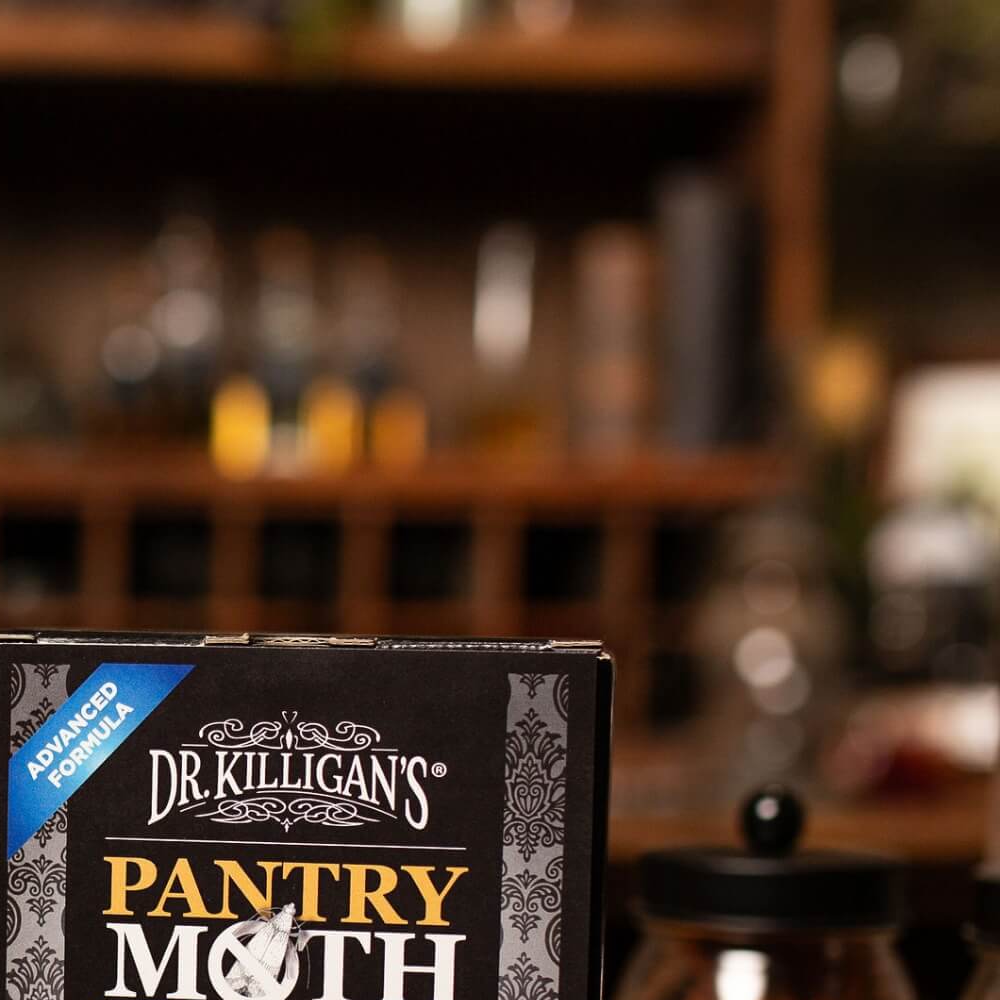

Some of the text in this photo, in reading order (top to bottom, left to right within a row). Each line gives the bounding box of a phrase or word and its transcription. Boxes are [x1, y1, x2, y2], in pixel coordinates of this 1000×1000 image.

[26, 682, 118, 780] ADVANCED
[47, 702, 134, 789] FORMULA
[102, 856, 469, 926] PANTRY
